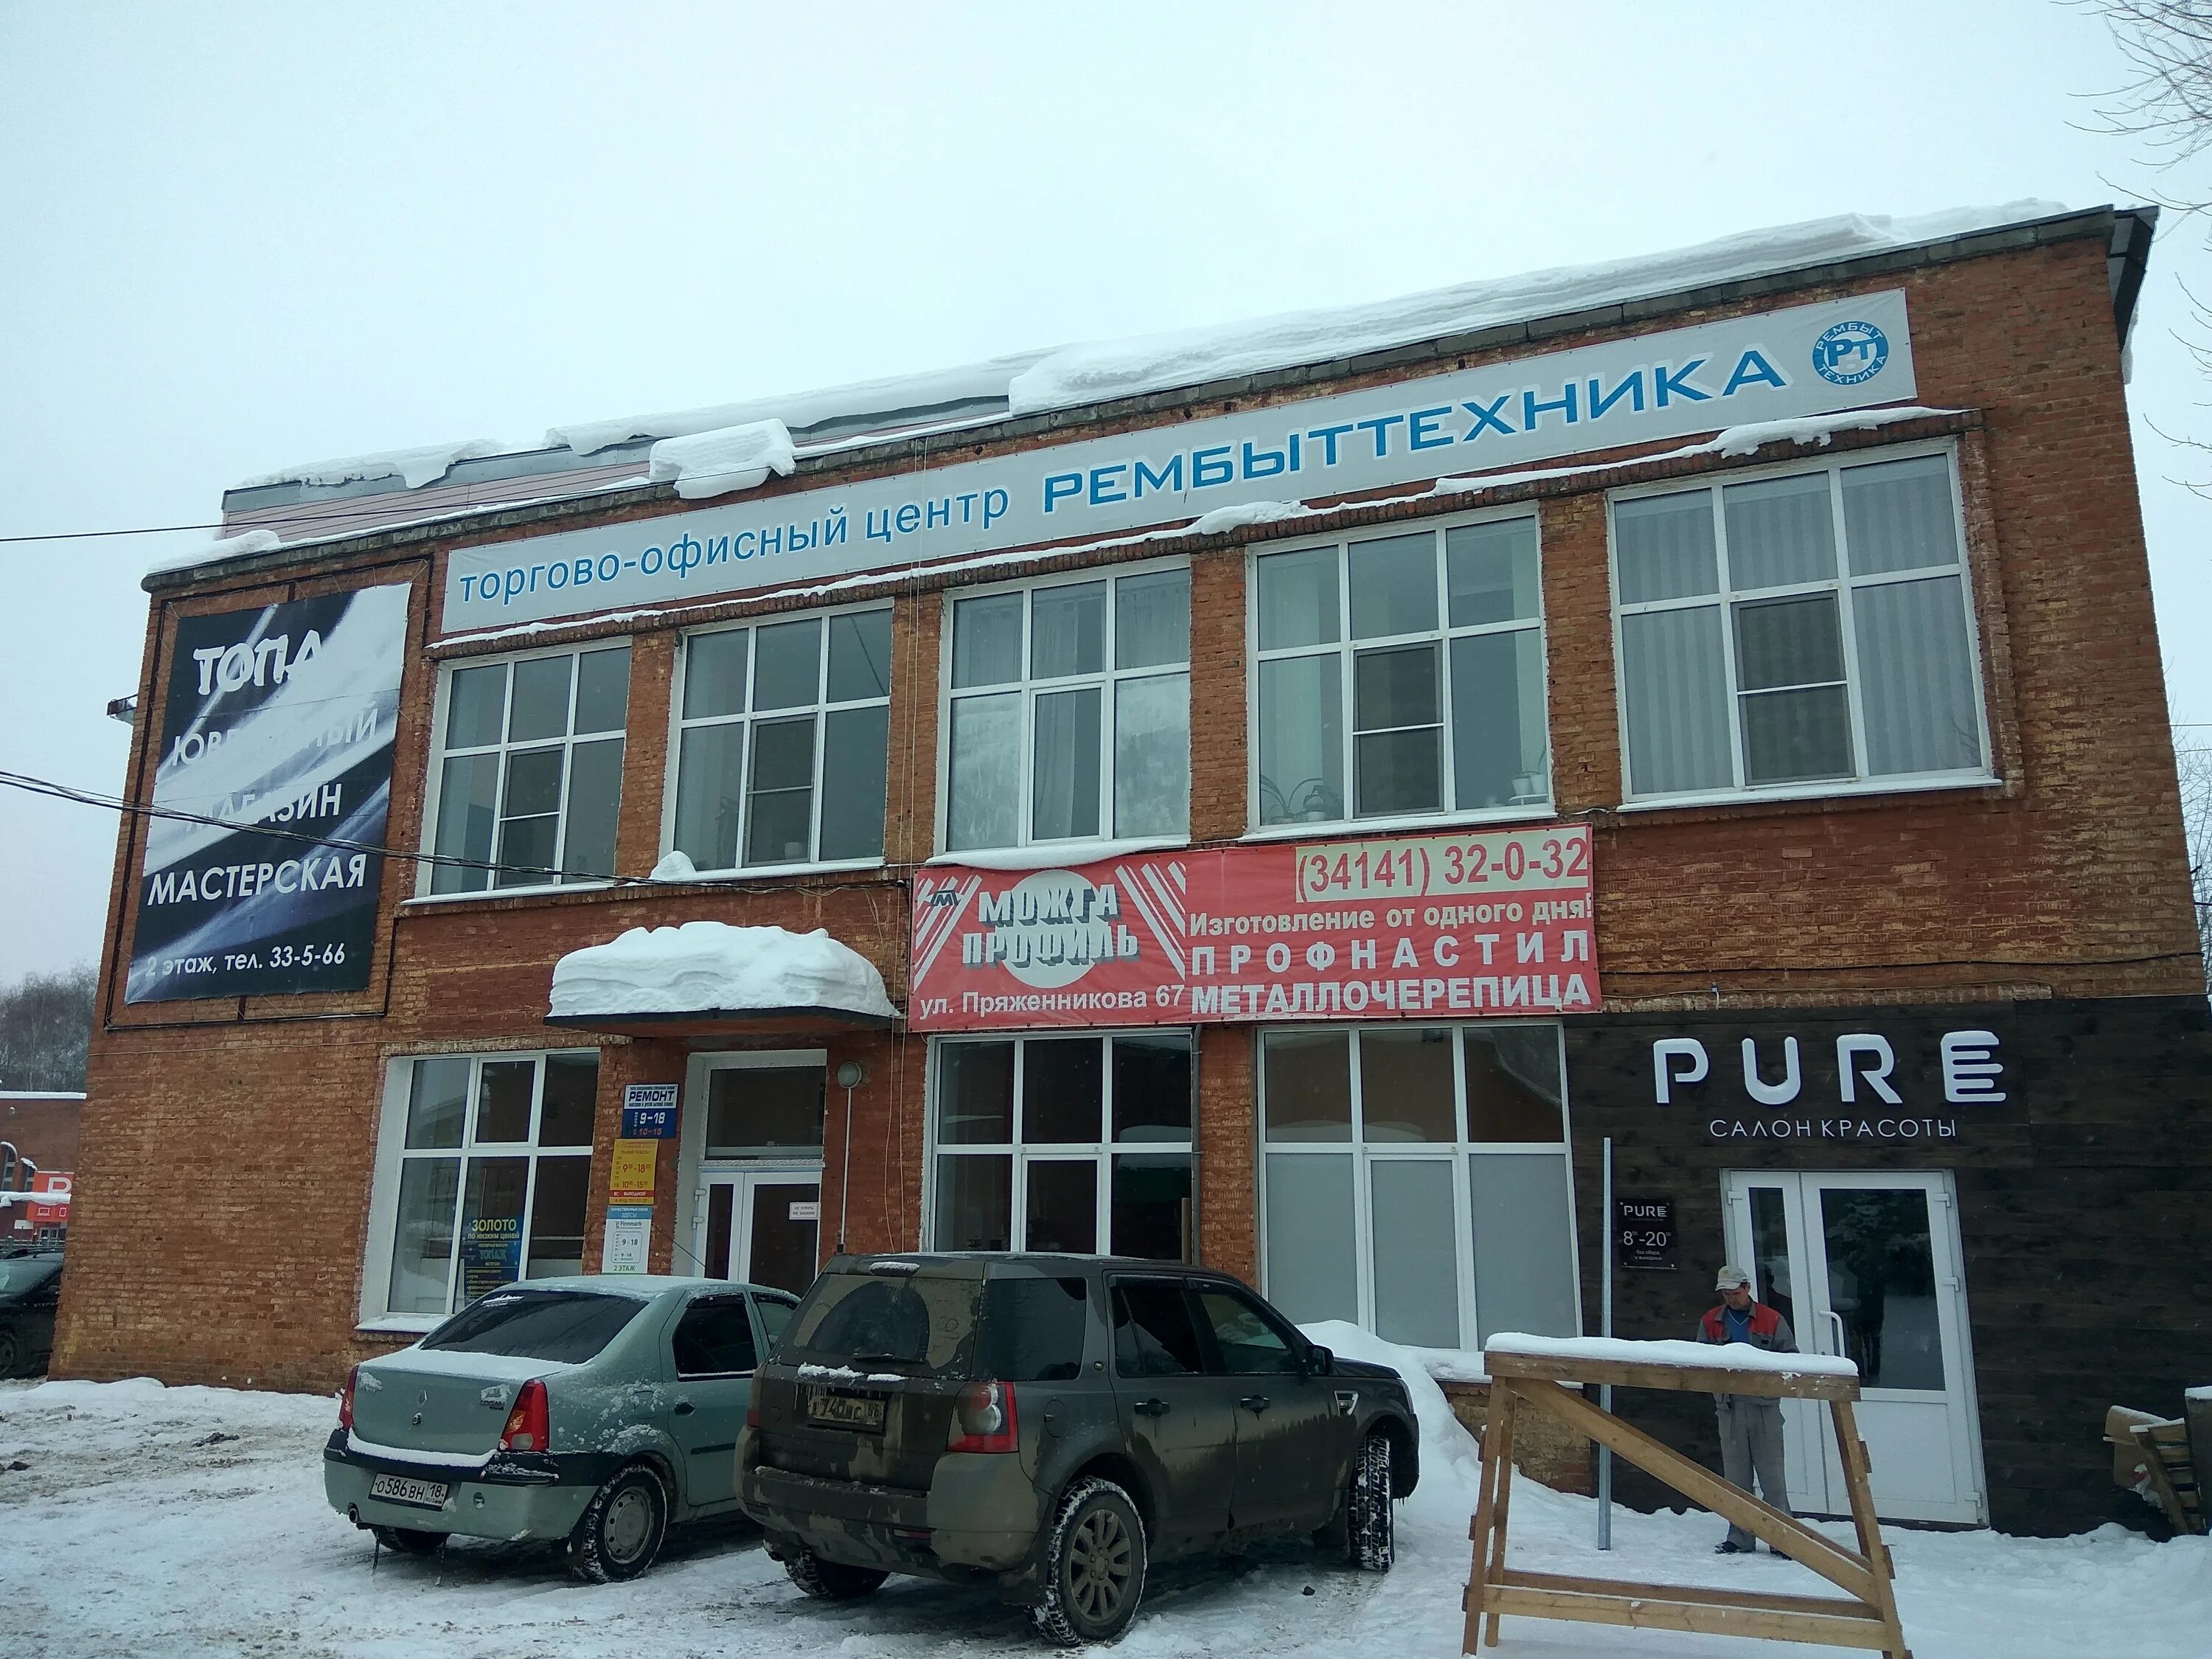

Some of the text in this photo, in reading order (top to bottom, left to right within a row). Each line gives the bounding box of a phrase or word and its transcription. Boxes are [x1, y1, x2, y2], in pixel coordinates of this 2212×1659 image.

[1815, 322, 1884, 350] РЕМБЫТ
[1818, 355, 1887, 384] ТЕХНИКА
[460, 349, 1787, 605] торгово-офисный центр РЕМБЫТТЕХНИКА
[192, 629, 323, 696] ТОПА
[147, 854, 367, 905] МАСТЕРСКАЯ
[1298, 837, 1588, 902] (34141) 32-0-32
[978, 884, 1121, 927] МОЖГА
[1190, 892, 1593, 937] Изготовление от одного дня!
[145, 943, 346, 977] 2 этаж, тел. 33-5-66
[962, 924, 1140, 967] ПРОФИЛЬ
[1191, 930, 1589, 975] ПРОФНАСТИЛ
[919, 984, 1185, 1020] ул. Пряженникова 67
[1192, 973, 1591, 1015] МЕТАЛЛОЧЕРЕПИЦА
[1653, 1030, 2006, 1105] PURE
[629, 1091, 675, 1102] РЕМОНТ
[639, 1112, 666, 1124] 9-18
[1710, 1119, 1957, 1138] САЛОН КРАСОТЫ
[471, 1218, 517, 1231] ЗОЛОТО
[1624, 1205, 1668, 1217] PURE
[377, 1477, 442, 1500] О586ВН 18
